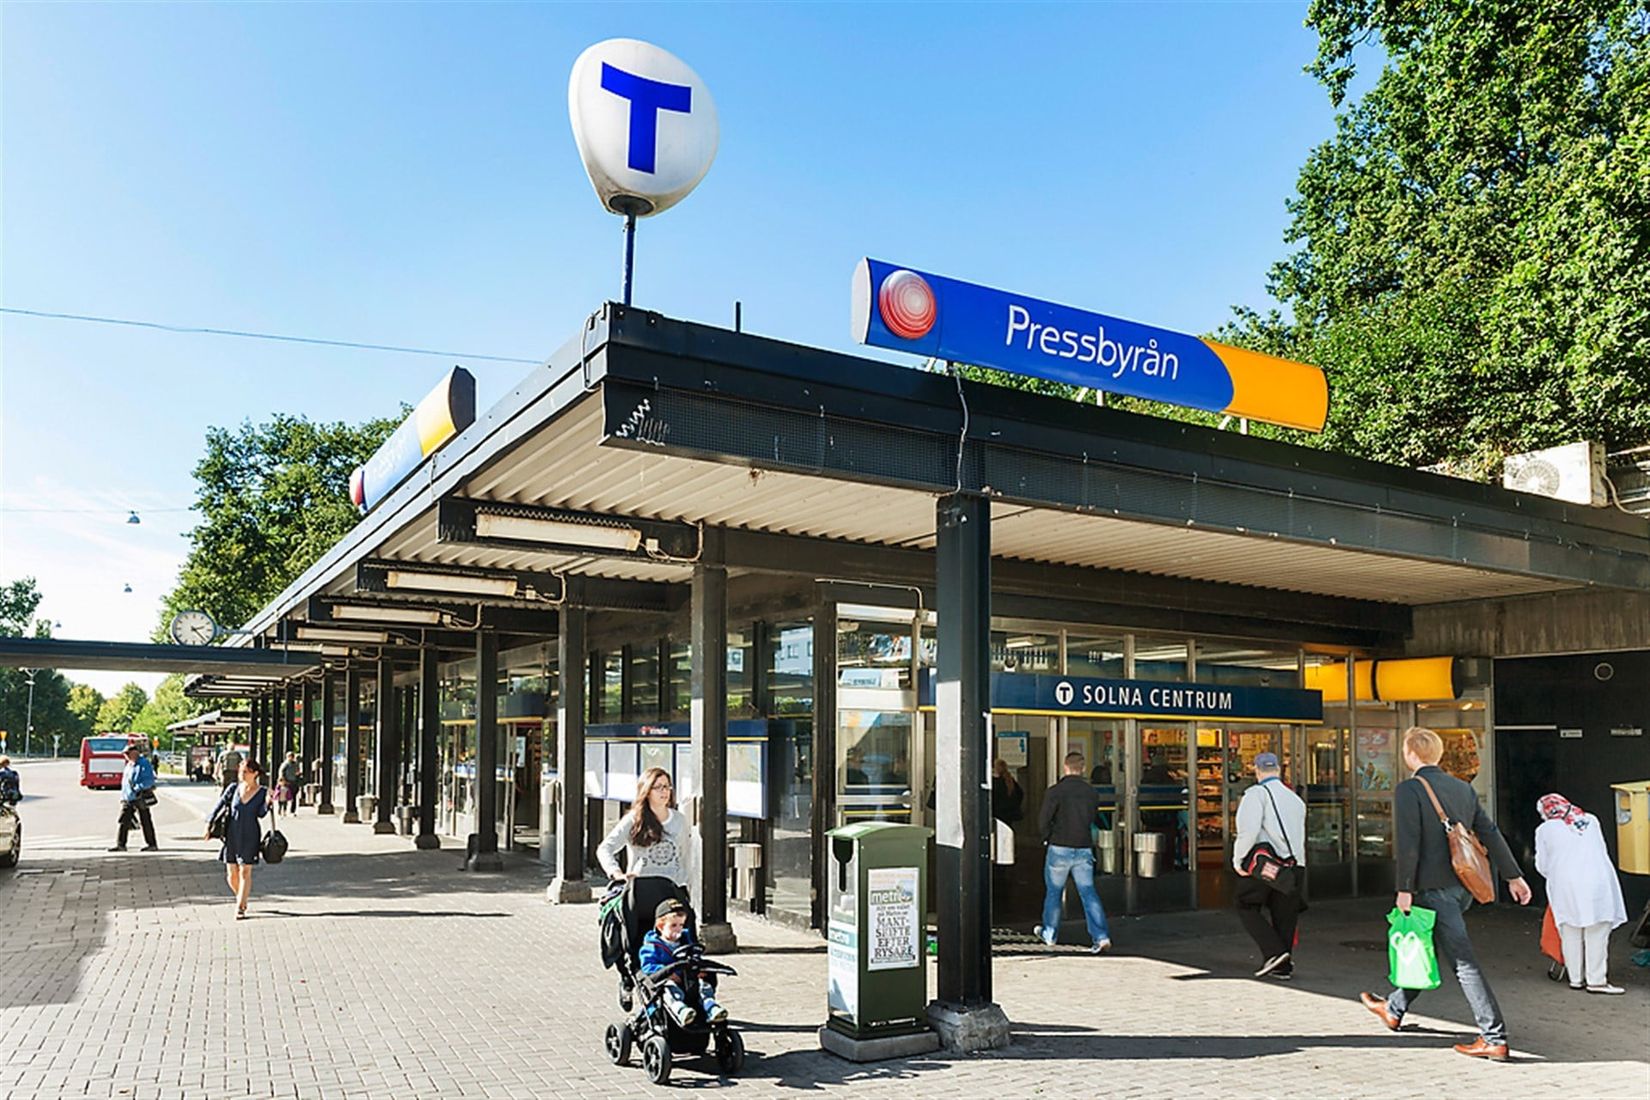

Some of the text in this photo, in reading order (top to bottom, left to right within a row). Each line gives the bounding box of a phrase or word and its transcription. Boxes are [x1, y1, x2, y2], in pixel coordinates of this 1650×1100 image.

[601, 61, 692, 174] T
[1006, 304, 1178, 380] Pressbyrån
[1083, 685, 1143, 706] SOLNA
[1150, 688, 1232, 710] CENTRUM
